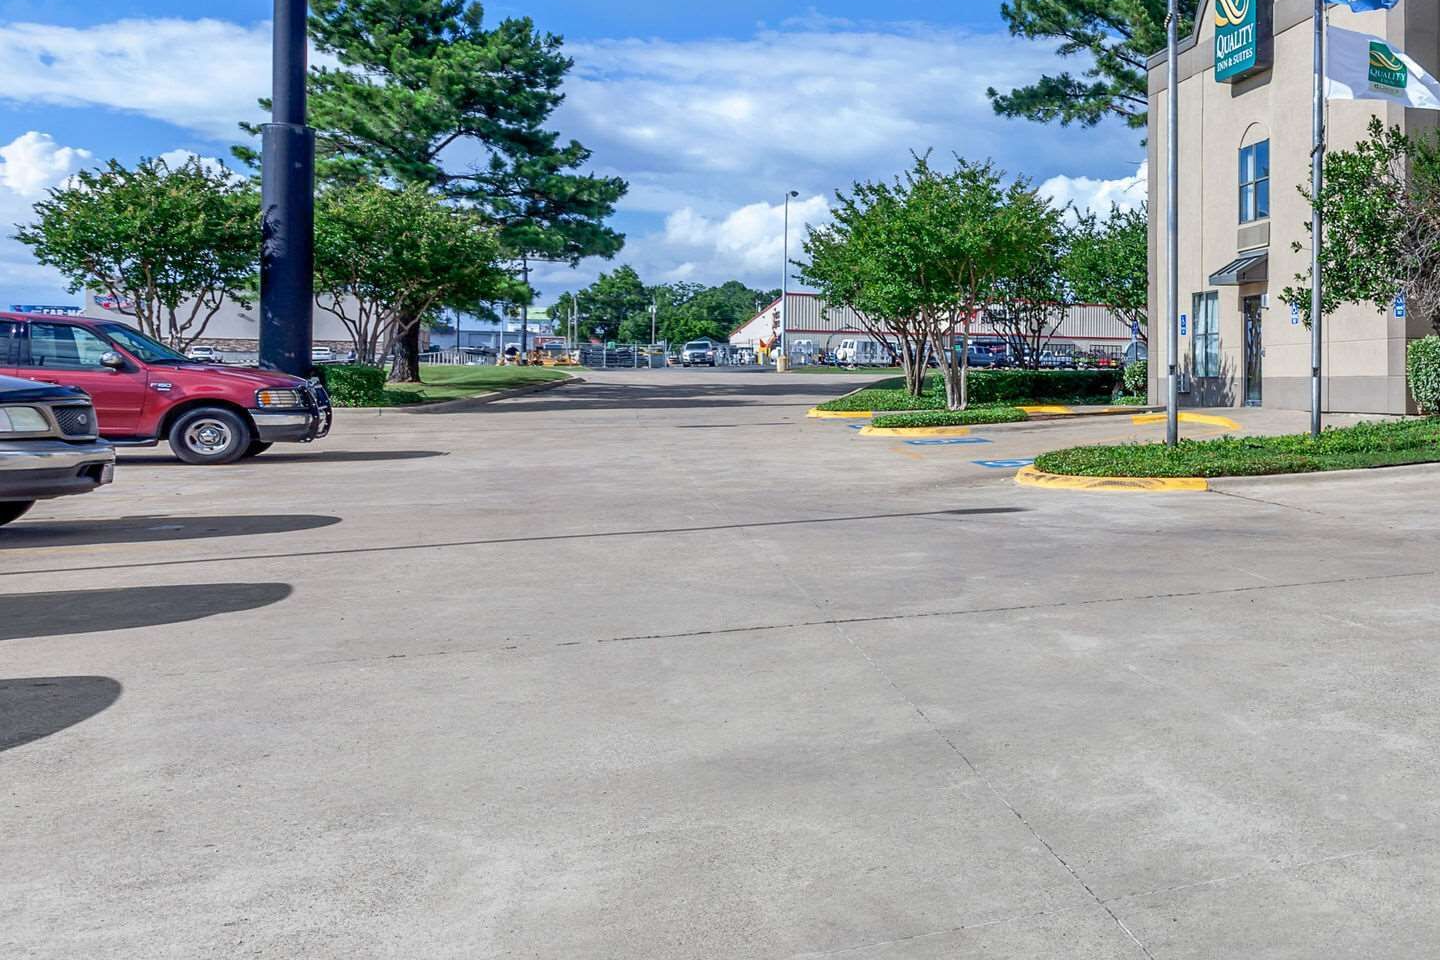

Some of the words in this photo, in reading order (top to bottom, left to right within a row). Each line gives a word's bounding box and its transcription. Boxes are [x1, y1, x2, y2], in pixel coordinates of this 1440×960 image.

[1217, 23, 1253, 59] QUALITY
[1217, 59, 1228, 72] INN
[1233, 48, 1253, 64] SUITES
[1370, 69, 1406, 80] QUALITY
